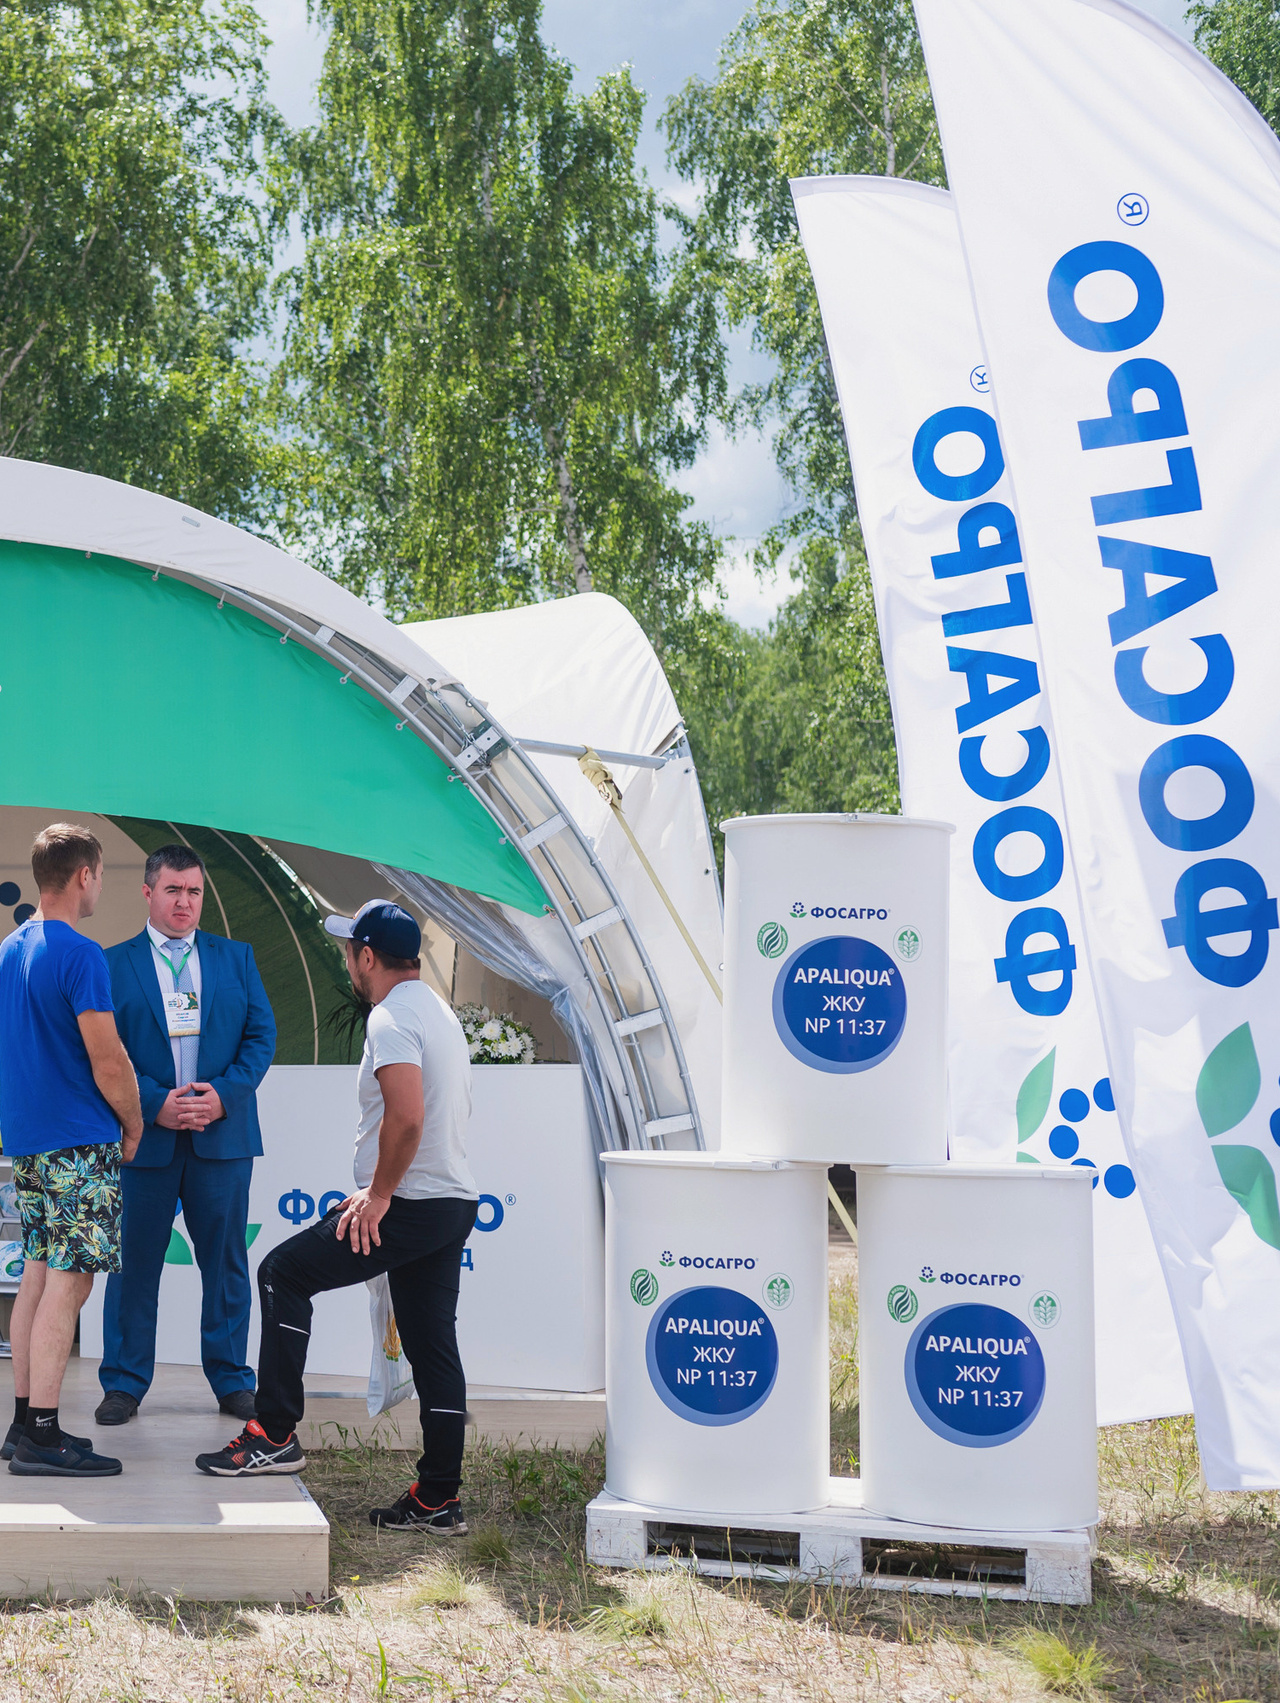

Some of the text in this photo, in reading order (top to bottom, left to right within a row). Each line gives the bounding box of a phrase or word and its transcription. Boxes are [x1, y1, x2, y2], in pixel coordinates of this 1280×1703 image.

[810, 906, 888, 920] ФОСАГРО
[822, 995, 866, 1012] ЖКУ
[805, 1017, 887, 1036] NP 11:37
[678, 1255, 756, 1270] ФОСАГРО
[939, 1271, 1022, 1287] ФОСАГРО
[692, 1346, 736, 1364] ЖКУ
[676, 1368, 758, 1387] NP 11:37
[955, 1365, 1001, 1384] ЖКУ
[938, 1387, 1024, 1408] NP 11:37
